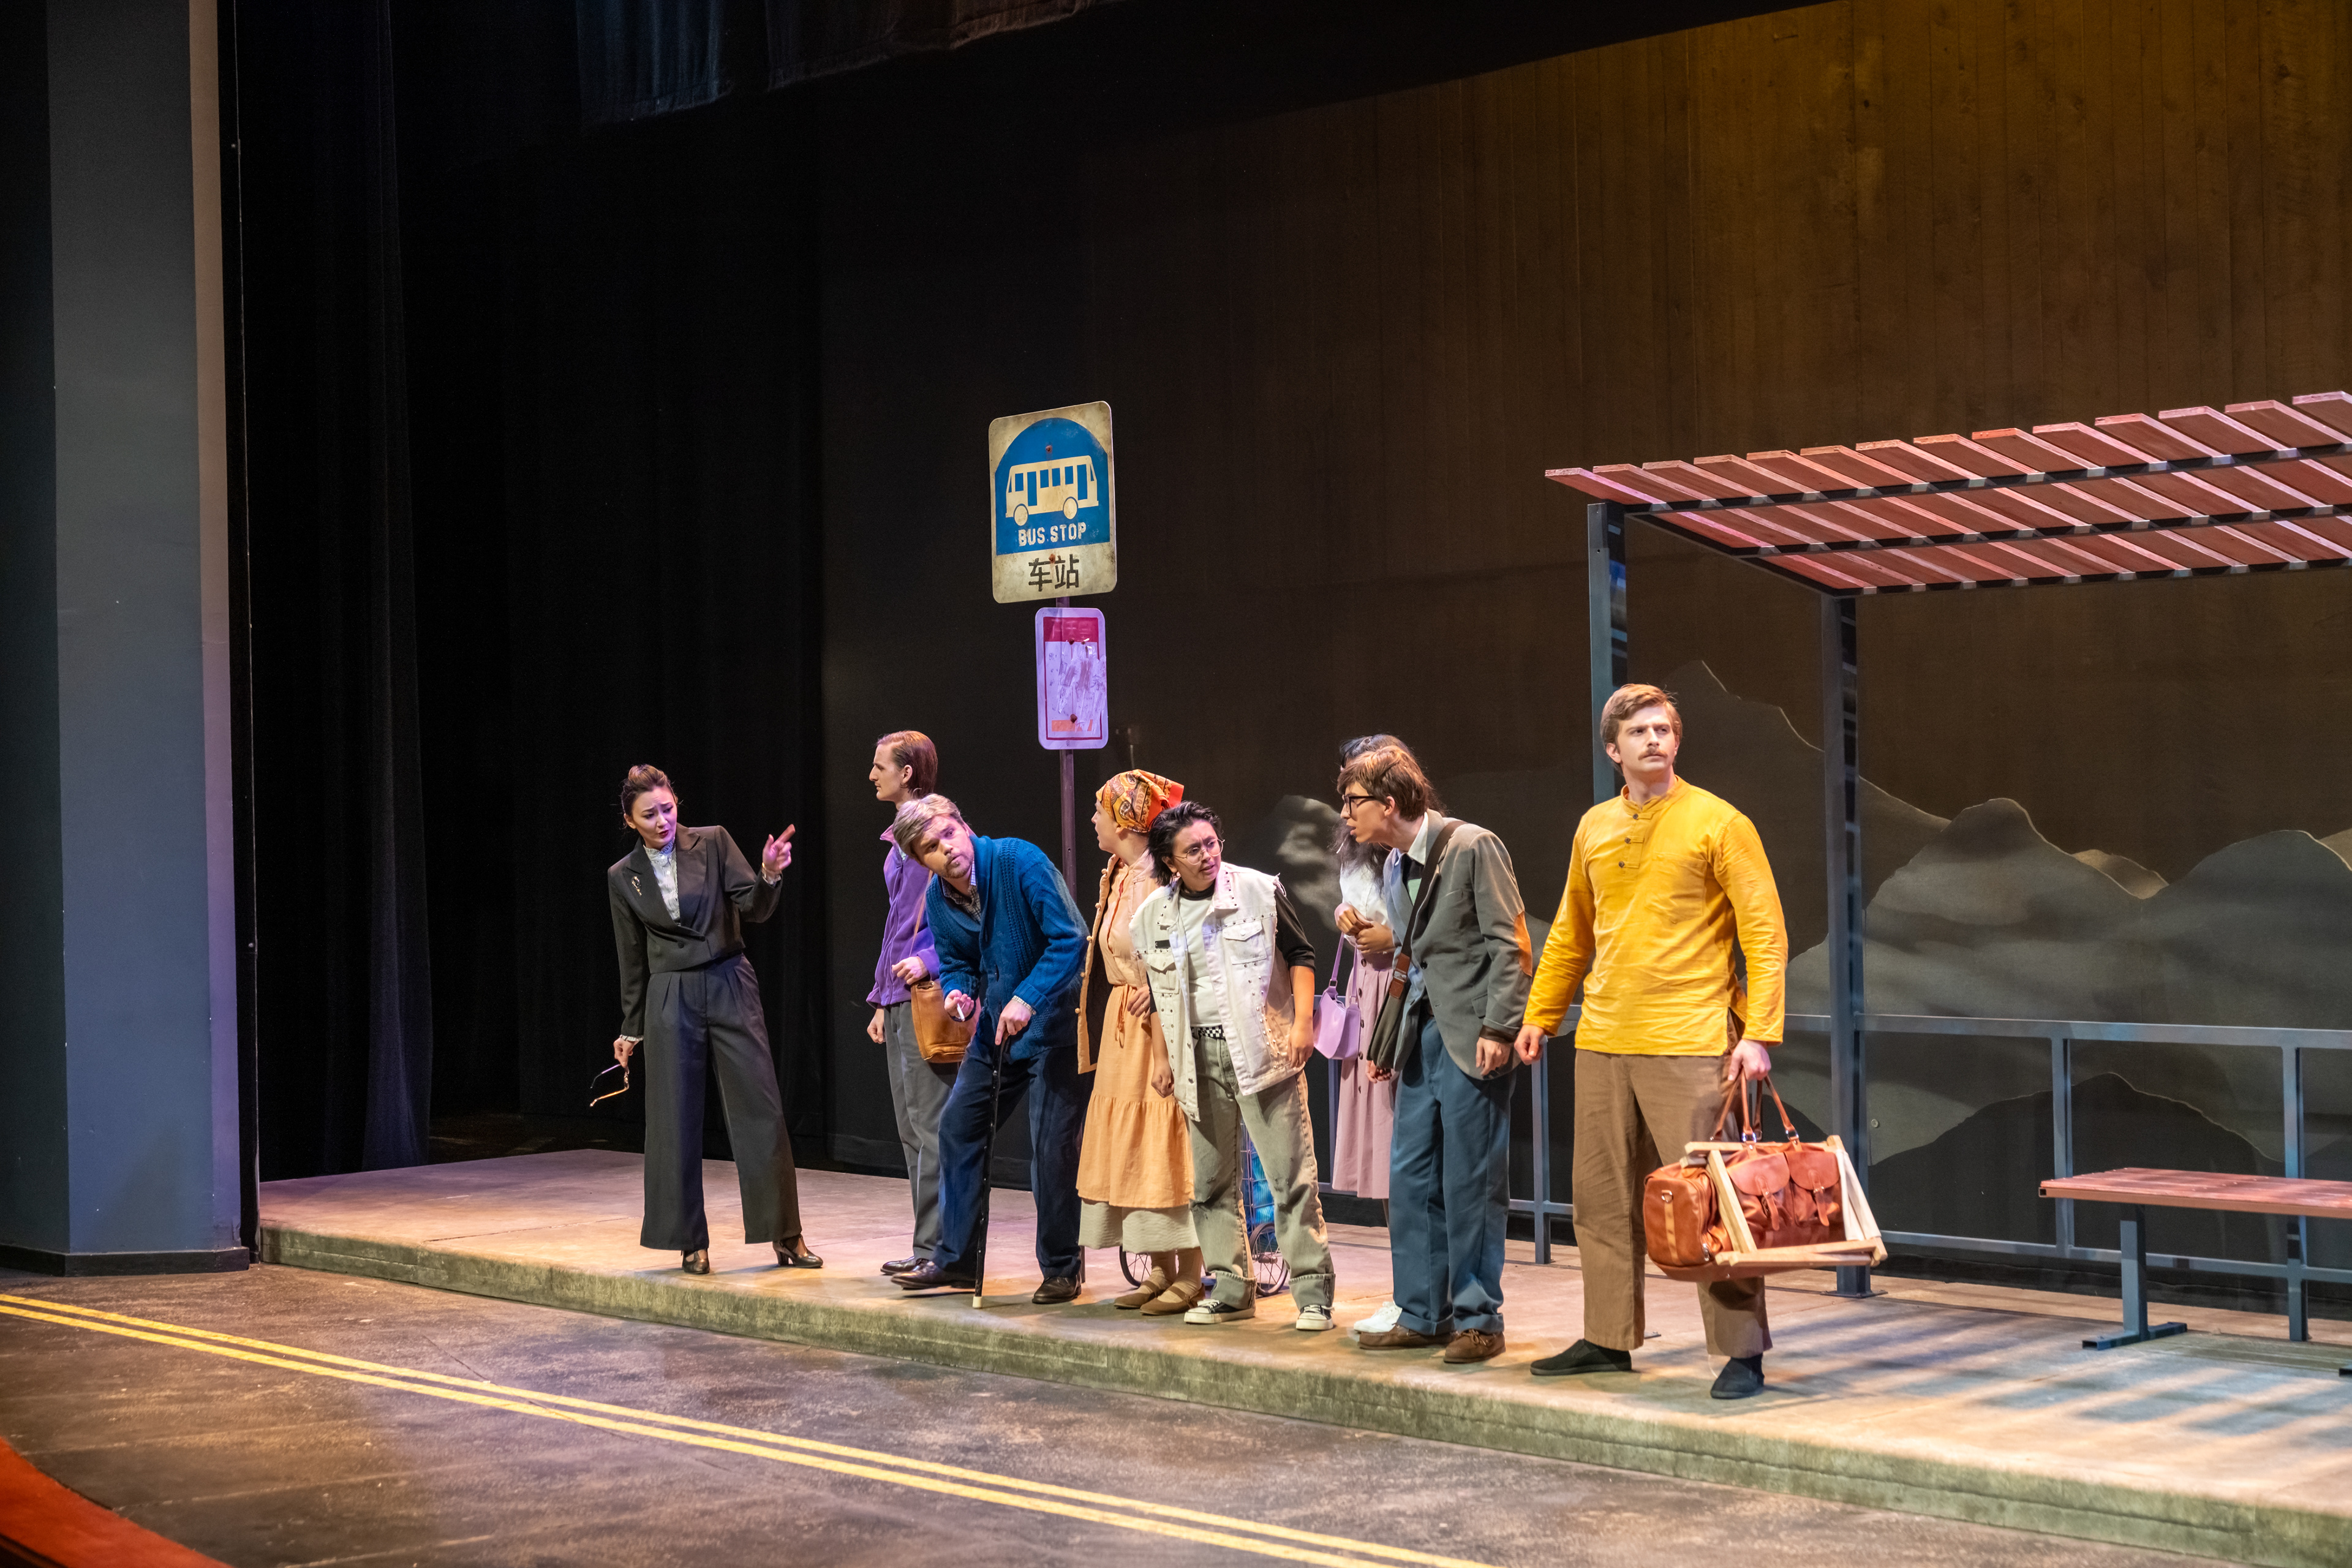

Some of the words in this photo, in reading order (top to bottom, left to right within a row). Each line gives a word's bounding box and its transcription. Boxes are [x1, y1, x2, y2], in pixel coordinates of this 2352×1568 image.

[1018, 527, 1046, 546] BUS
[1050, 522, 1087, 543] STOP
[1028, 554, 1079, 592] 车站
